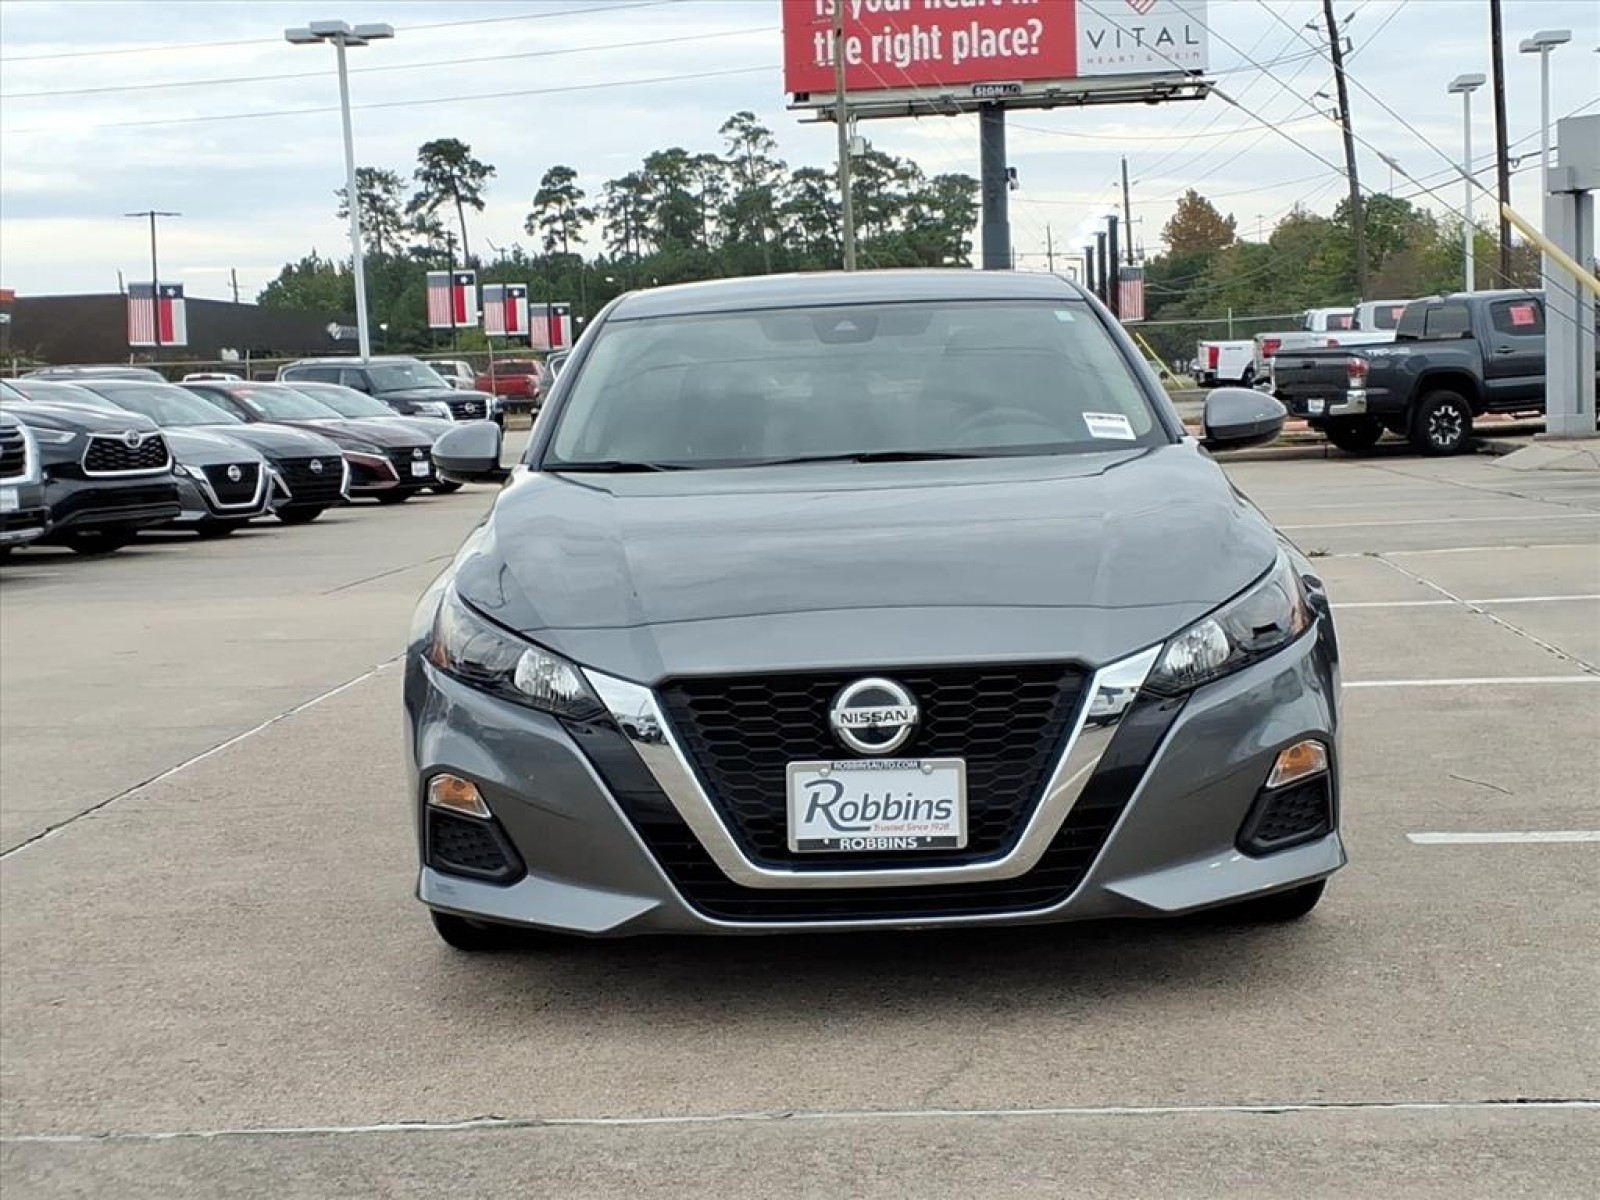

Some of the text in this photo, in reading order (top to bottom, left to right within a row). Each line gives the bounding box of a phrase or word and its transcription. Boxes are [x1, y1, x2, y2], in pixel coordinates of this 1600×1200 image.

[871, 24, 943, 68] right
[951, 18, 1043, 65] place?
[1086, 24, 1200, 50] VITAL
[1086, 54, 1135, 64] HEART
[840, 709, 909, 725] NISSAN
[804, 779, 953, 832] Robbins
[907, 823, 930, 832] Since
[840, 836, 918, 850] ROBBINS
